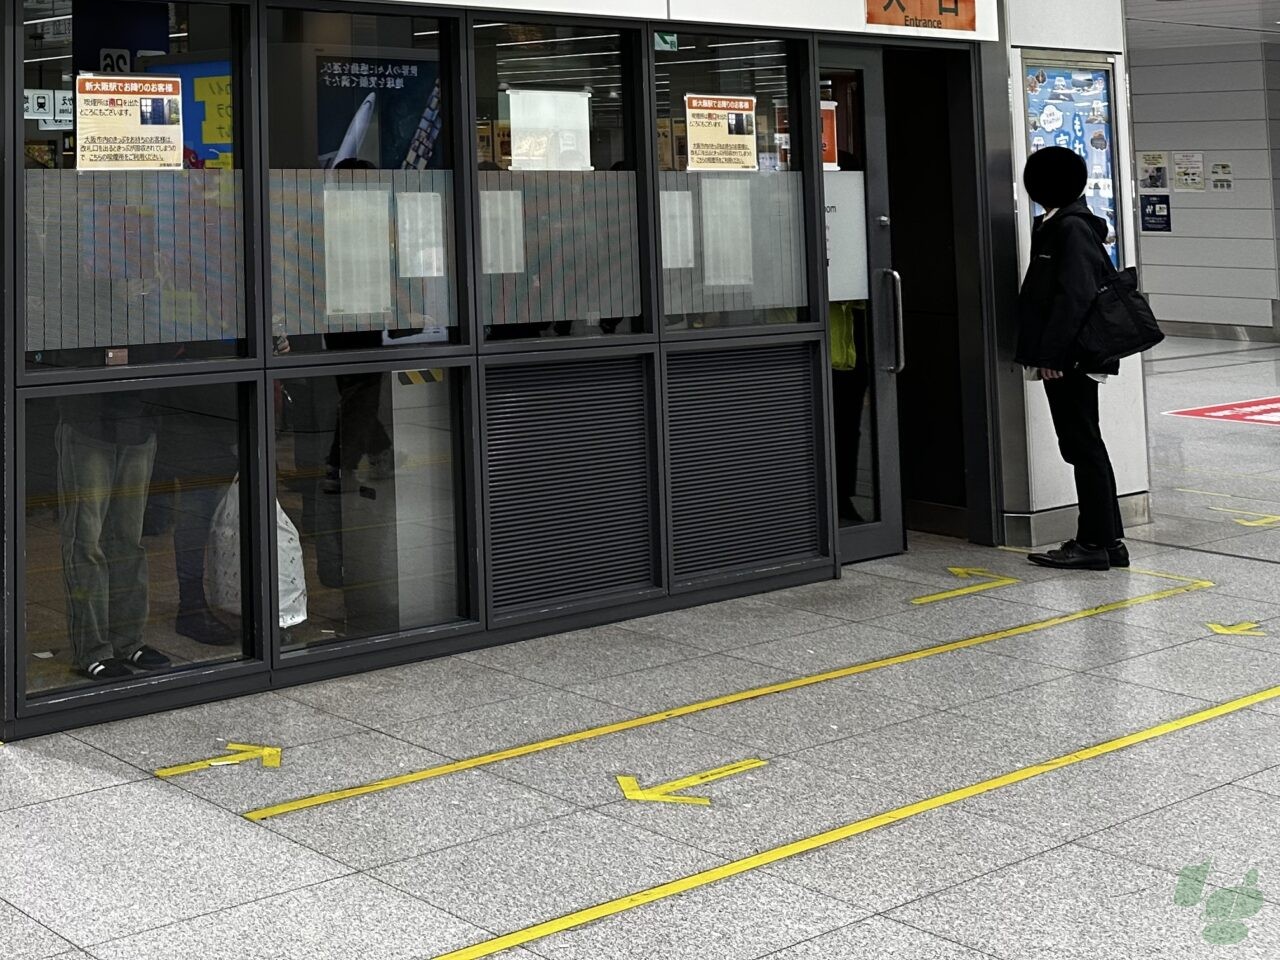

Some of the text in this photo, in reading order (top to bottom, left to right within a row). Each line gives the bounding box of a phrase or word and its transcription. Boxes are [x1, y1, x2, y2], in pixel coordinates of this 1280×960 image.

[904, 15, 942, 29] Entrance
[85, 82, 173, 93] 新大阪駅でお降りのお客様
